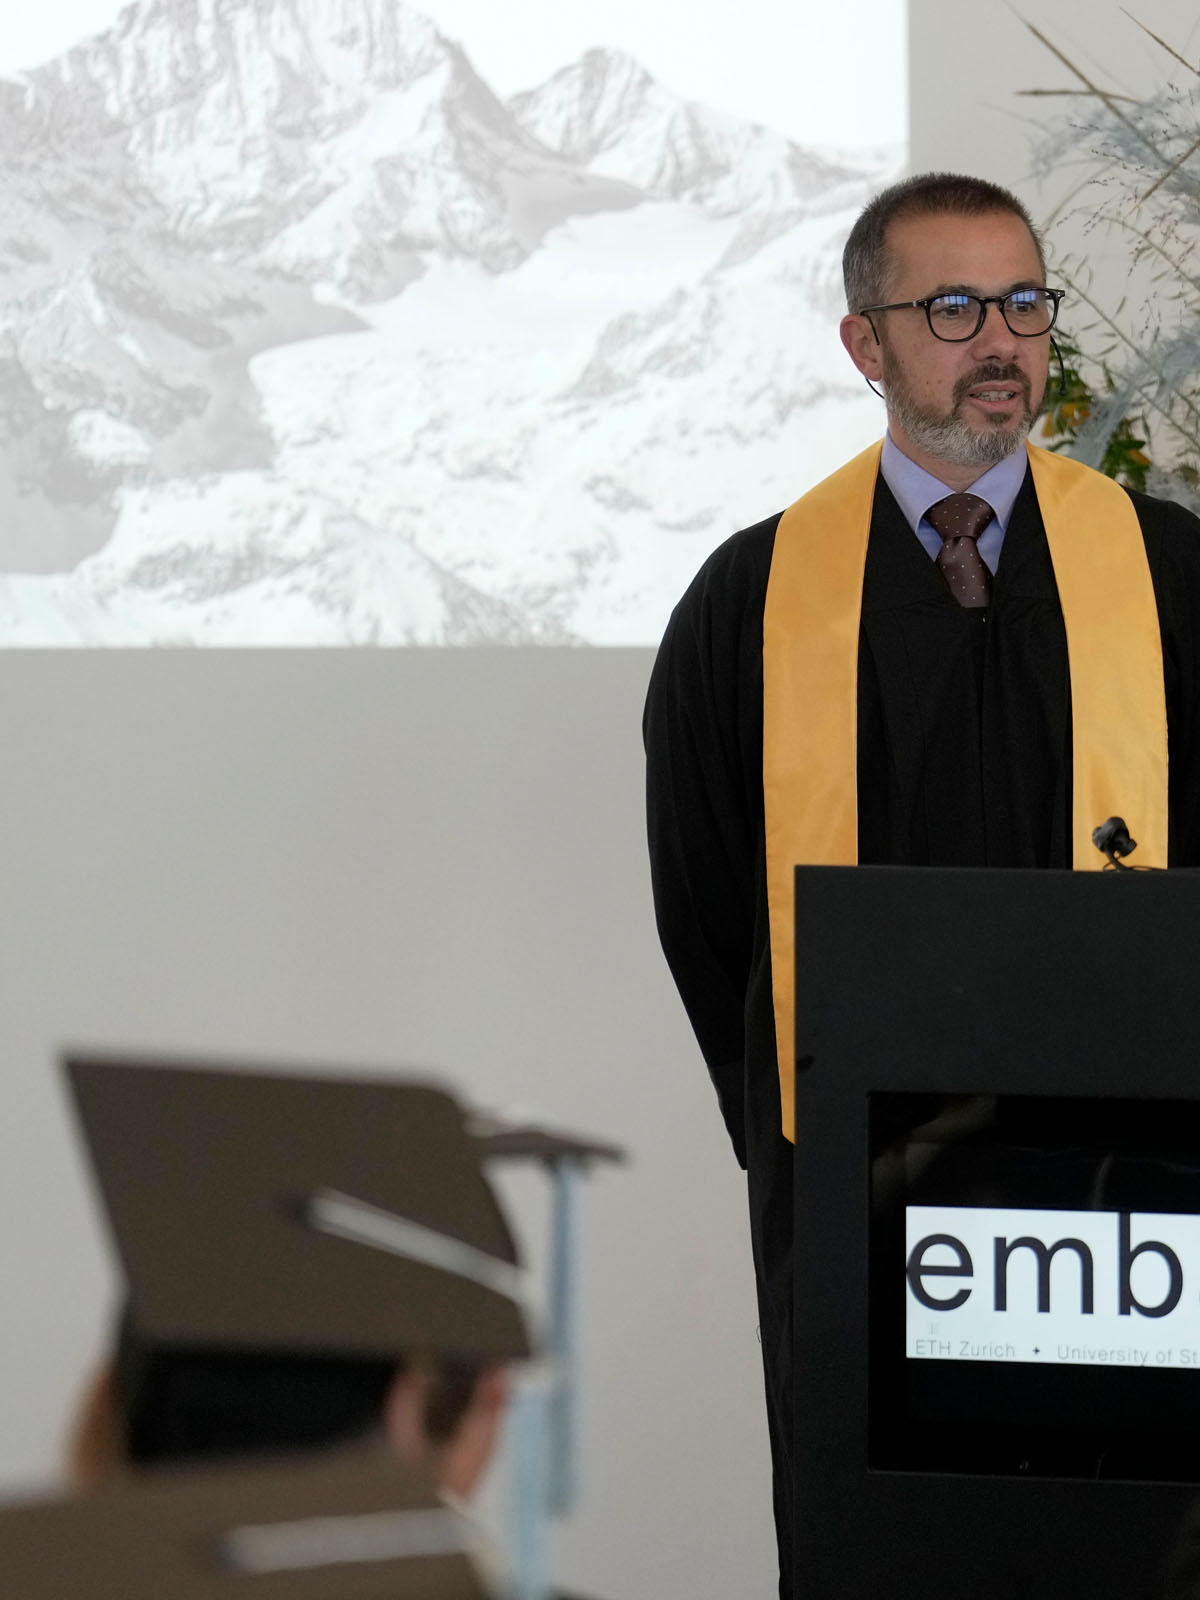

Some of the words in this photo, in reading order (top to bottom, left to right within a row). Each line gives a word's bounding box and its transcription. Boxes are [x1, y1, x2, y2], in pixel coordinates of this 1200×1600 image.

[915, 1339, 951, 1356] ETH
[959, 1340, 1016, 1358] Zurich
[1057, 1343, 1148, 1367] University
[1155, 1347, 1174, 1364] of
